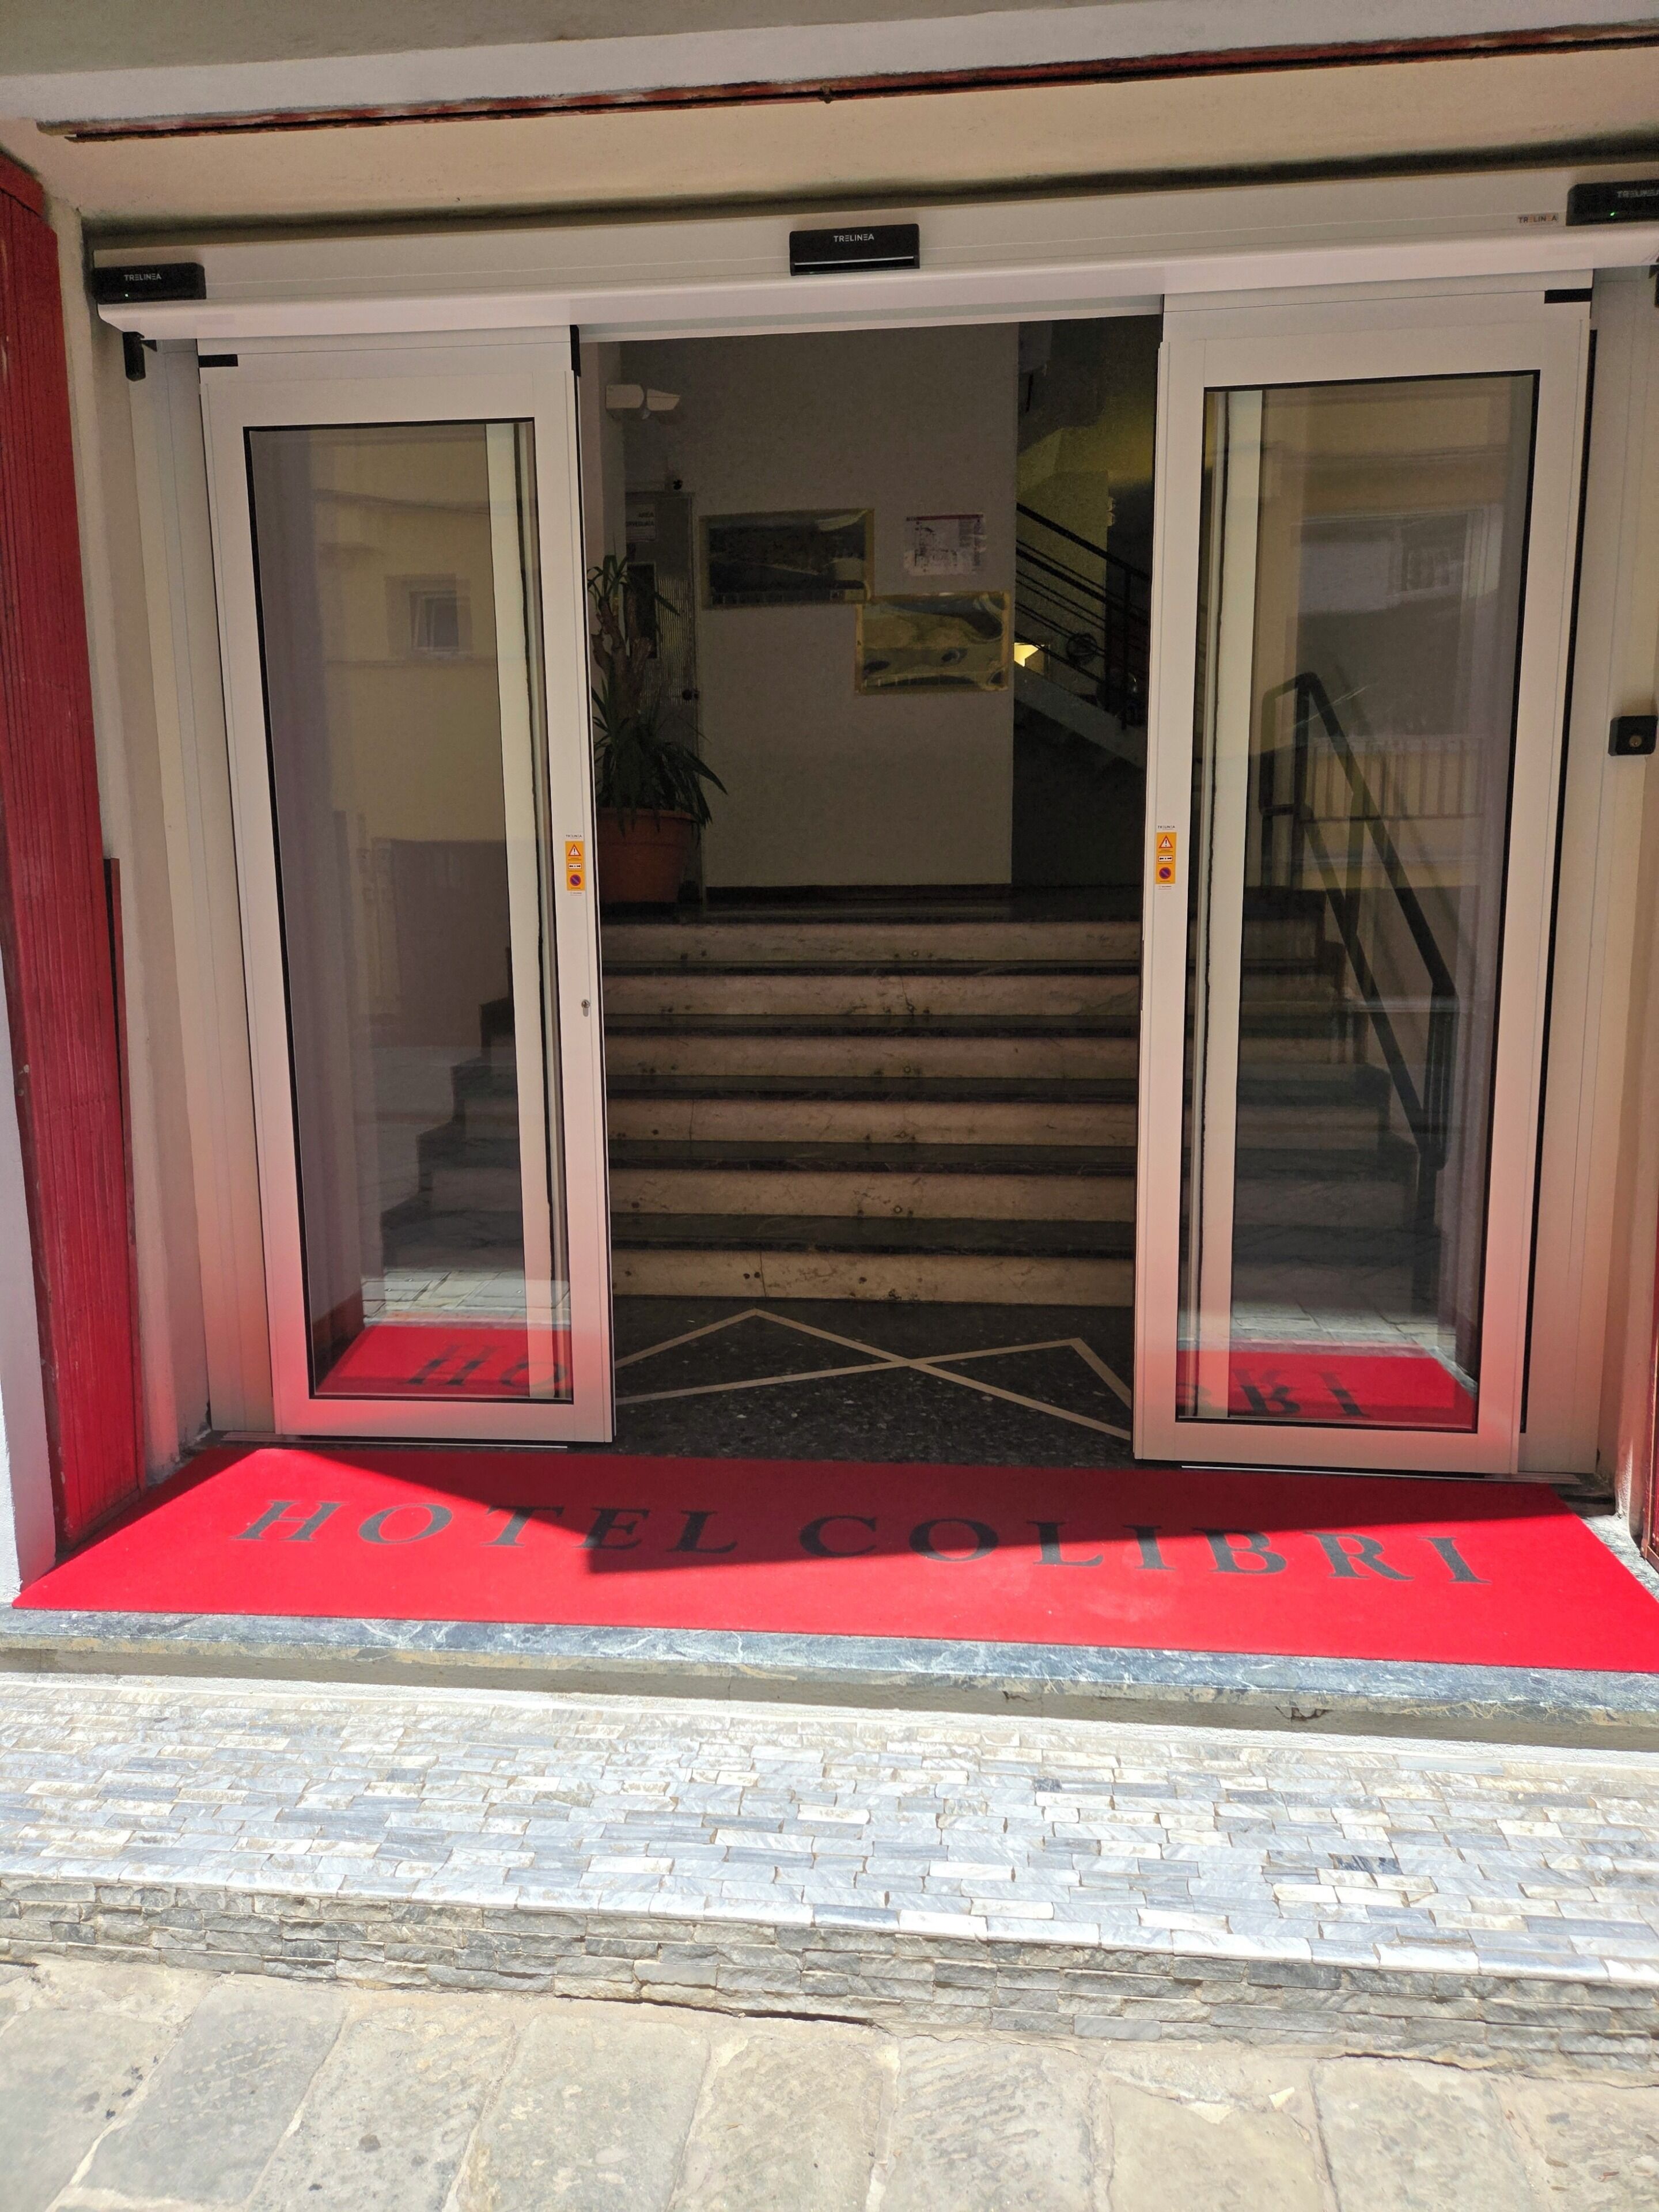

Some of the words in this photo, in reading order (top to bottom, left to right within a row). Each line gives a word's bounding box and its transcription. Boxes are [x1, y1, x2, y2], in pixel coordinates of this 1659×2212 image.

[834, 234, 874, 242] TRELINEA
[232, 1501, 738, 1554] HOTEL
[799, 1514, 1492, 1584] COLIBRI
